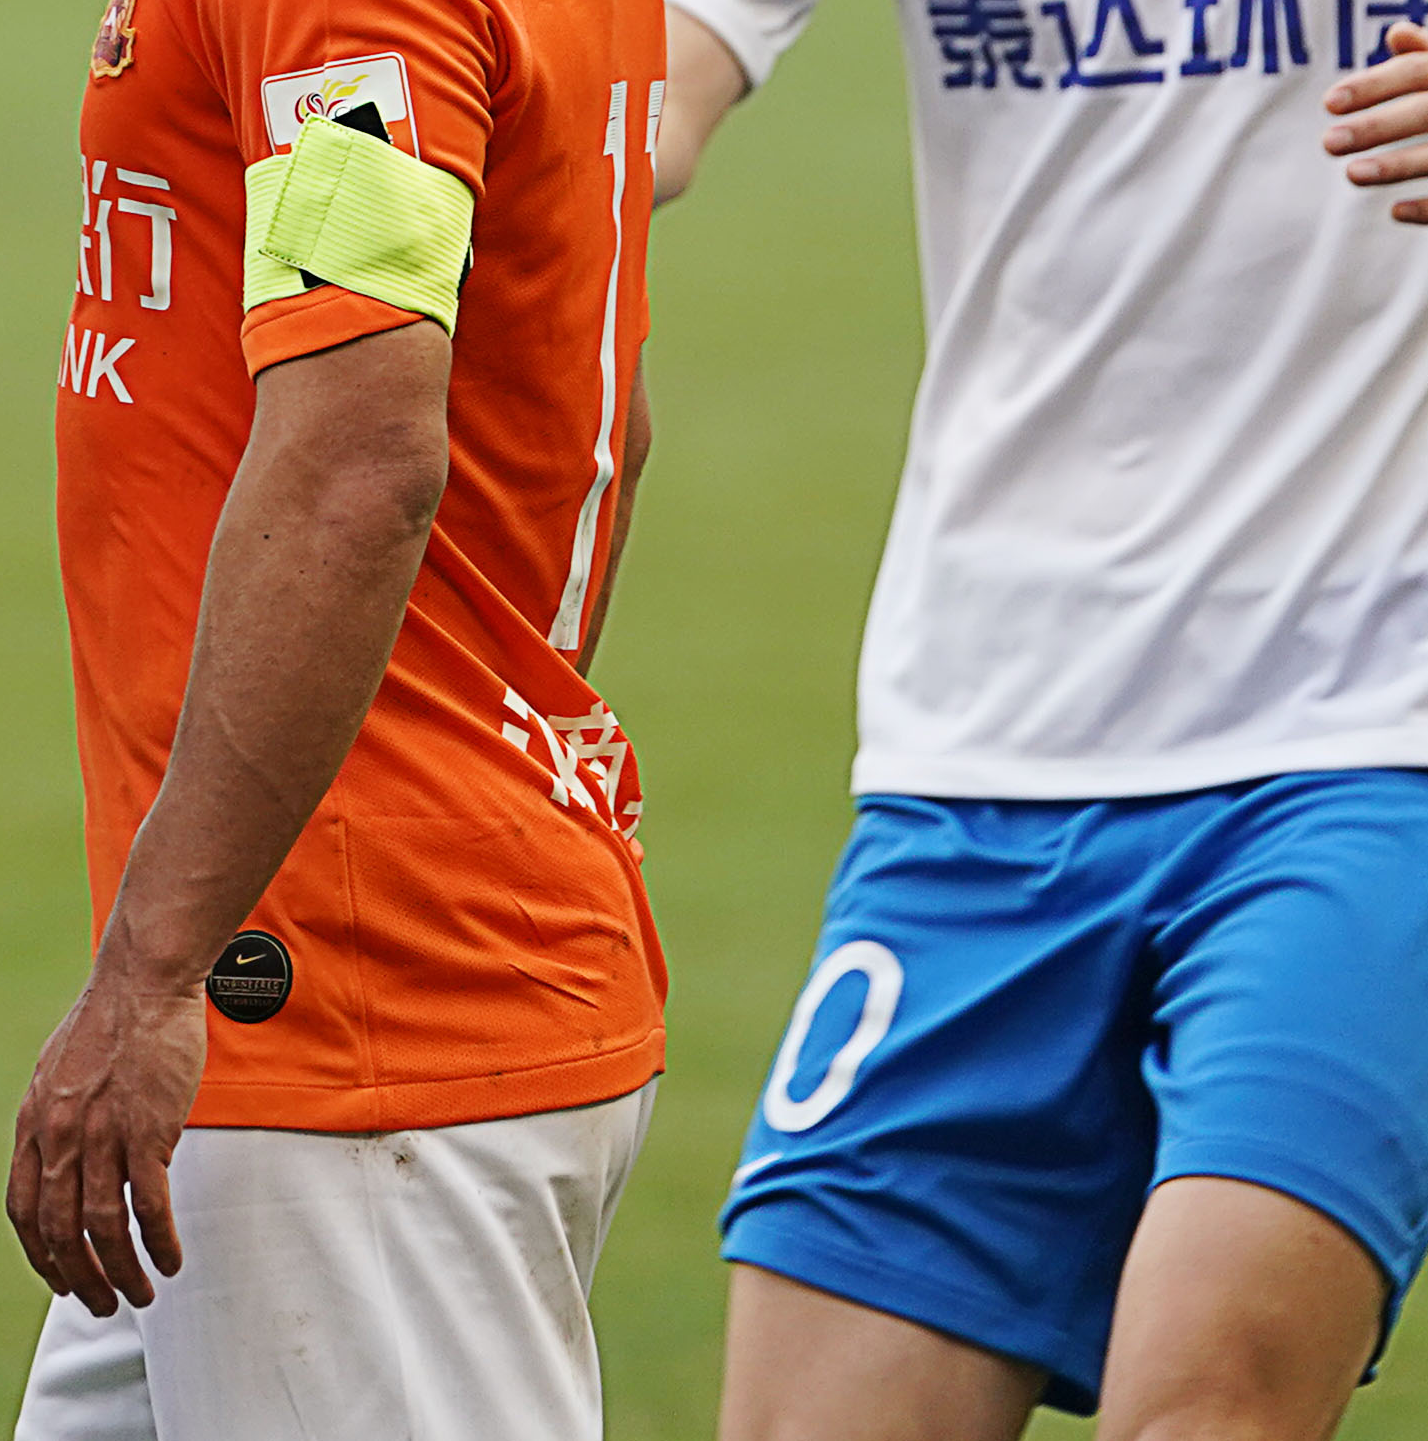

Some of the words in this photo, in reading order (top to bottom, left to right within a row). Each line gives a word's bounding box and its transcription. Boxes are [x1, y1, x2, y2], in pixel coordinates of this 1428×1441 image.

[75, 154, 178, 311] 行
[57, 323, 137, 404] NK
[763, 939, 905, 1133] 0
